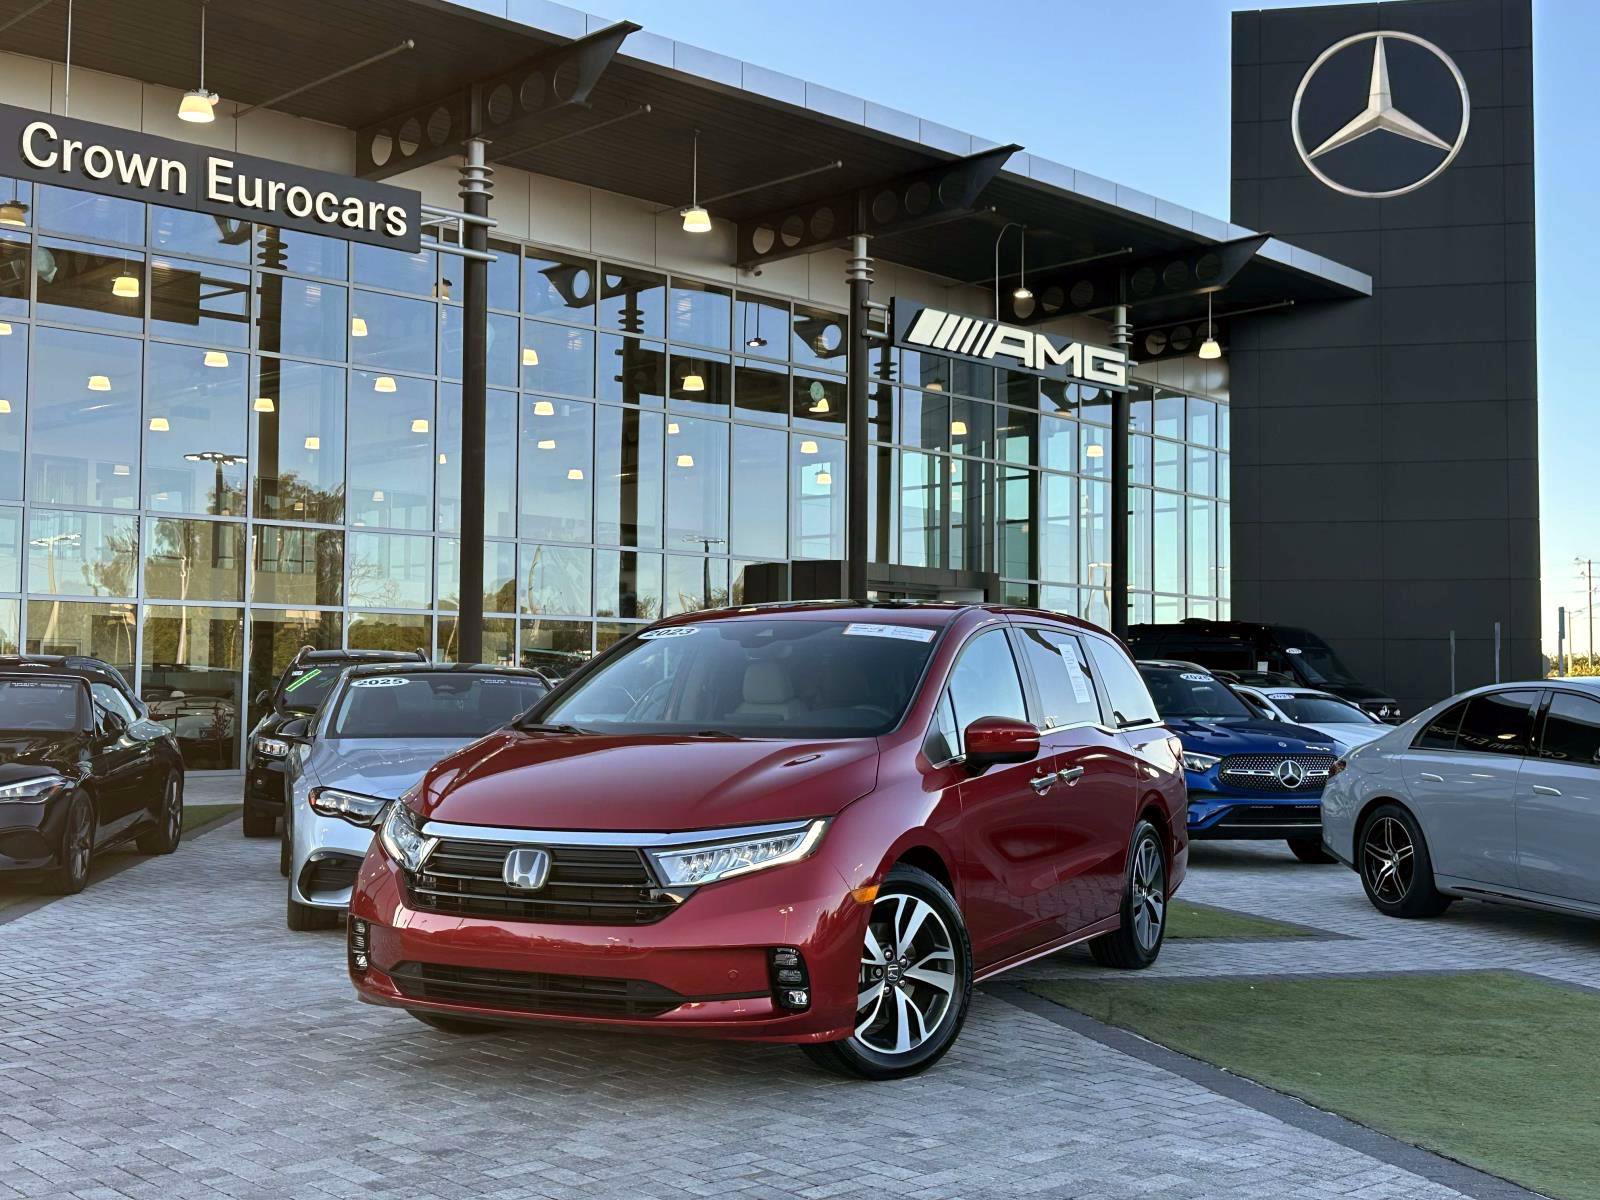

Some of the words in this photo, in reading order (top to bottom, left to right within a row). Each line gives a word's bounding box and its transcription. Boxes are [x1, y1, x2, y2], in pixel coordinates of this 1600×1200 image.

[22, 121, 187, 195] Crown
[207, 156, 408, 237] Eurocars
[983, 324, 1126, 387] AMG
[357, 678, 403, 686] 2025
